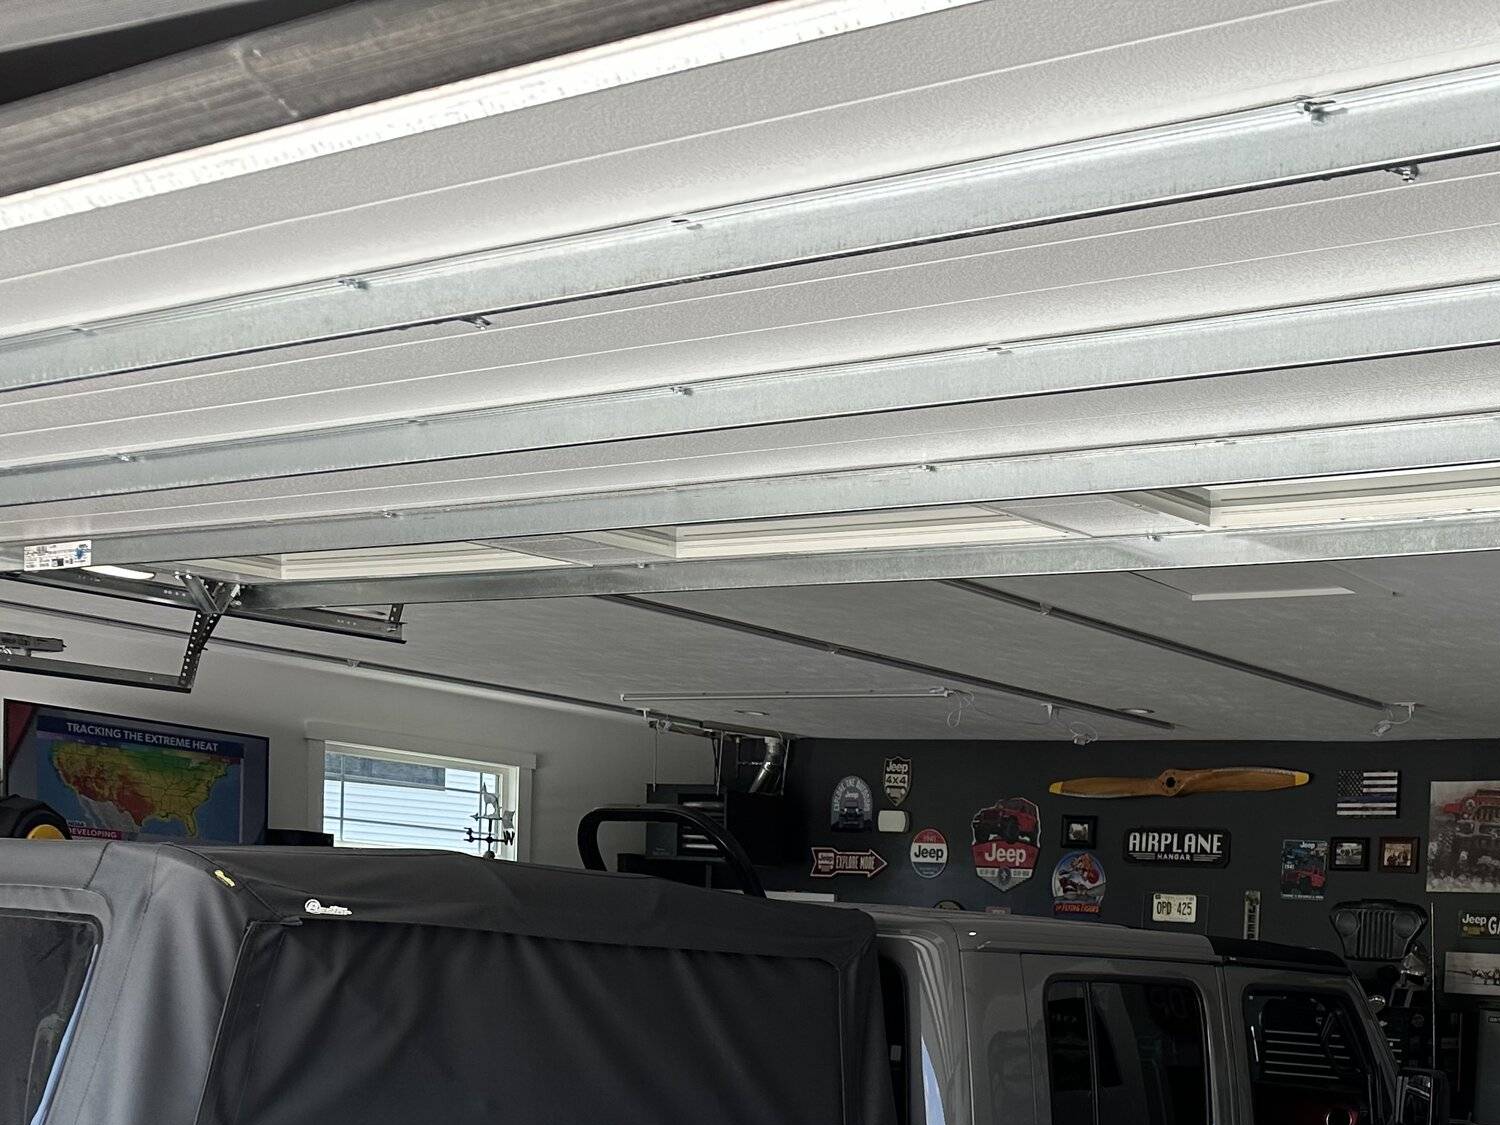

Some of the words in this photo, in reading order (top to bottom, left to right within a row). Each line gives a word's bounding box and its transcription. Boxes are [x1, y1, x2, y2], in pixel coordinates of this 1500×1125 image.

[66, 722, 121, 738] TRACKING
[121, 730, 144, 742] THE
[145, 734, 191, 748] EXTREME
[192, 741, 219, 752] HEAT
[1128, 832, 1223, 854] AIRPLANE
[914, 845, 944, 861] Jeep
[985, 842, 1027, 866] Jeep
[1156, 853, 1191, 861] HANGAR
[1177, 902, 1192, 915] 425
[1462, 913, 1487, 926] Jeep
